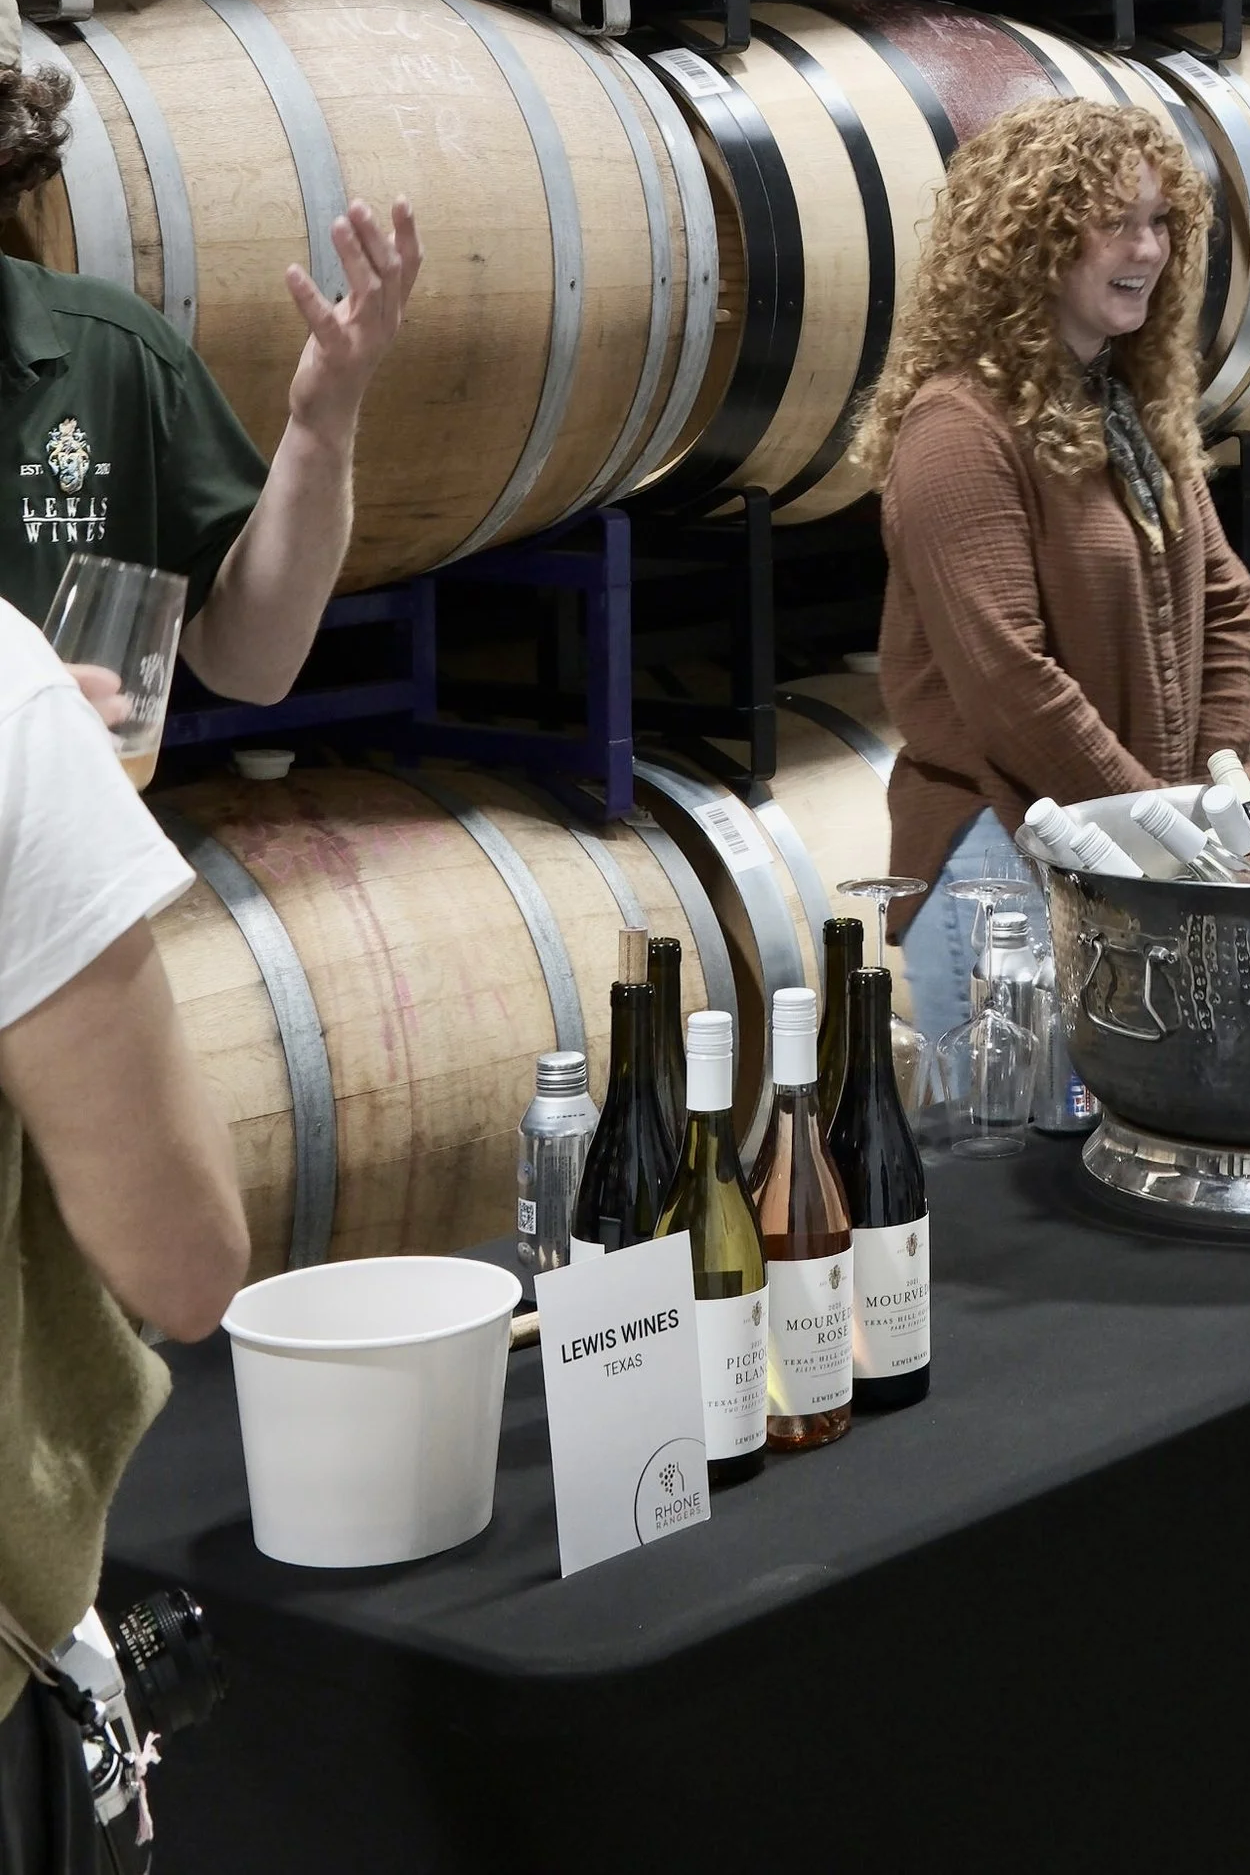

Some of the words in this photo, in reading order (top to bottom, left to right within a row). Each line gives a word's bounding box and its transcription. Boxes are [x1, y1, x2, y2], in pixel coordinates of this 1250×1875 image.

[20, 464, 44, 476] EST.
[22, 497, 108, 518] LEWIS
[24, 522, 106, 543] WINES
[864, 1318, 893, 1326] TEXAS
[561, 1329, 617, 1364] LEWIS
[621, 1309, 680, 1345] WINES
[604, 1353, 643, 1377] TEXAS
[783, 1357, 814, 1366] TEXAS
[891, 1356, 912, 1367] LEWIS
[707, 1397, 738, 1407] TEXAS
[811, 1394, 834, 1404] LEWIS
[735, 1433, 755, 1446] LEWIS
[655, 1492, 700, 1521] RHONE
